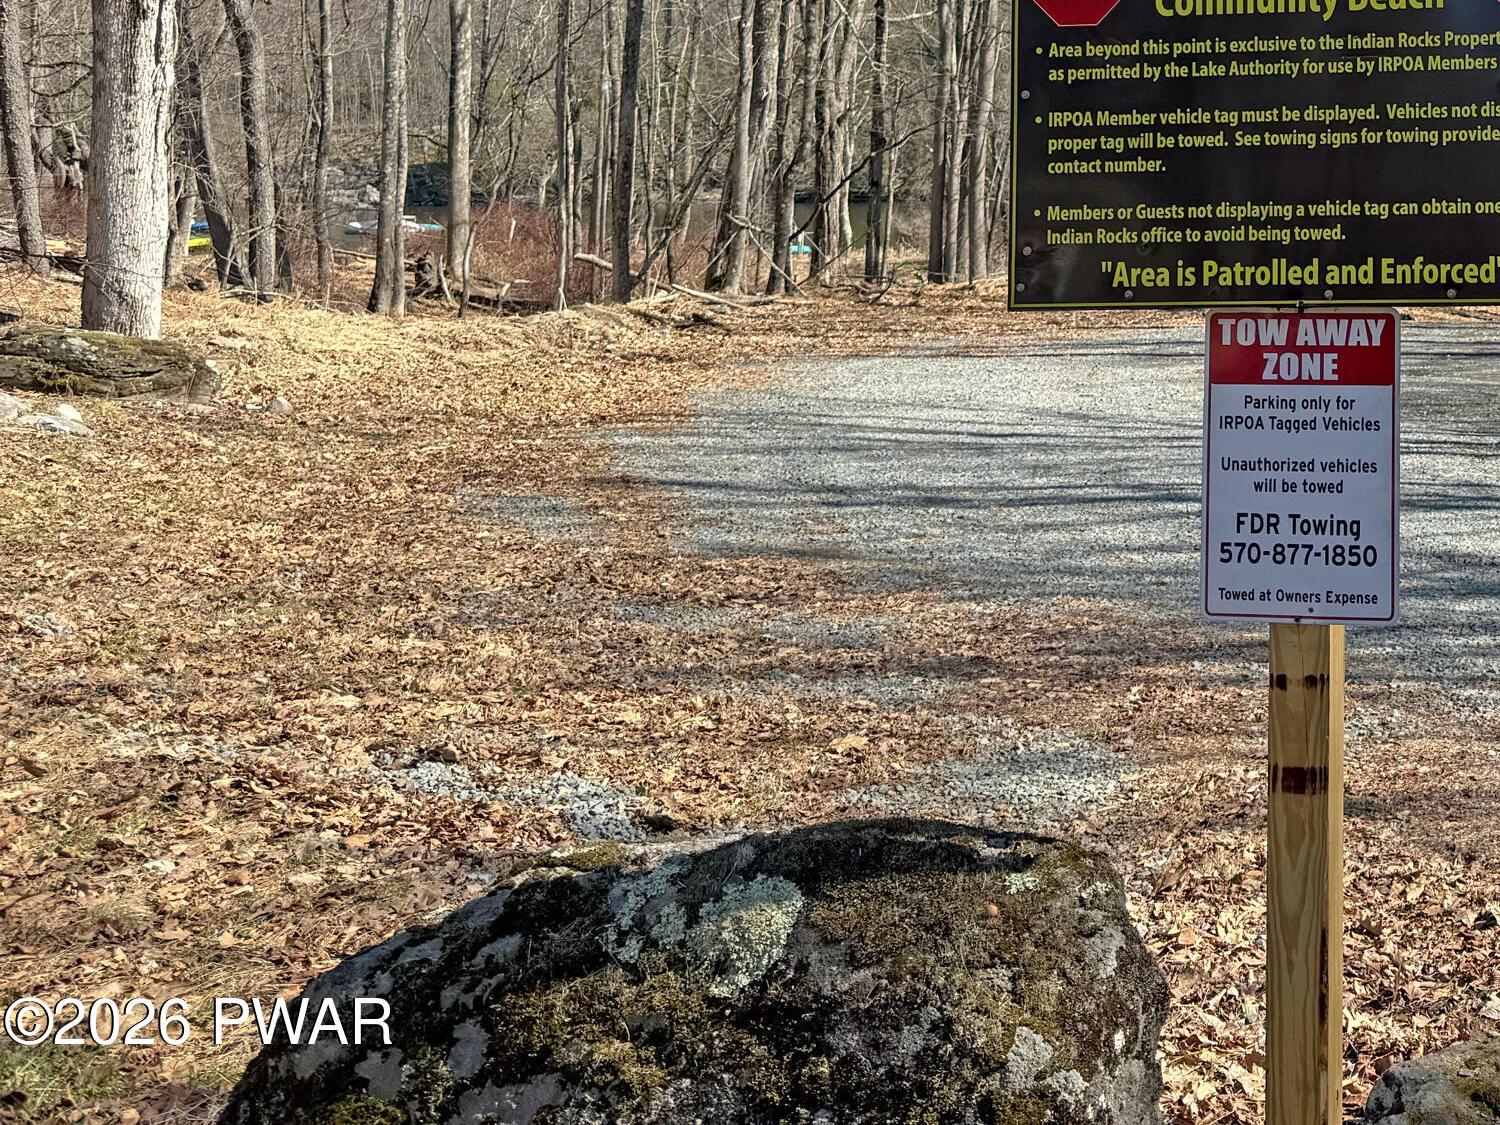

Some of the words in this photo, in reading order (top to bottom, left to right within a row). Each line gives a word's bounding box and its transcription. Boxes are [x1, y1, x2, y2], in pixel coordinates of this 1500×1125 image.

[1049, 43, 1082, 57] Area
[1086, 40, 1139, 60] beyond
[1143, 39, 1169, 54] this
[1174, 38, 1211, 57] point
[1216, 38, 1226, 52] is
[1230, 36, 1297, 52] exclusive
[1300, 37, 1315, 50] to
[1319, 35, 1343, 49] the
[1348, 33, 1394, 49] Indian
[1399, 32, 1440, 47] Rocks
[1049, 70, 1064, 80] as
[1068, 63, 1139, 84] permitted
[1144, 63, 1161, 82] by
[1164, 62, 1188, 77] the
[1192, 61, 1225, 76] Lake
[1229, 59, 1299, 78] Authority
[1303, 58, 1324, 73] for
[1328, 62, 1353, 73] use
[1357, 57, 1374, 76] by
[1379, 56, 1424, 71] IRPOA
[1428, 54, 1497, 70] Members
[1049, 112, 1093, 127] IRPOA
[1097, 110, 1156, 125] Member
[1160, 108, 1210, 124] vehicle
[1214, 110, 1238, 126] tag
[1242, 108, 1278, 122] must
[1283, 106, 1300, 121] be
[1387, 103, 1448, 119] Vehicles
[1452, 104, 1477, 117] not
[1049, 139, 1097, 154] proper
[1100, 136, 1123, 153] tag
[1127, 133, 1153, 148] will
[1157, 133, 1174, 147] be
[1235, 131, 1261, 146] See
[1264, 130, 1316, 148] towing
[1320, 129, 1357, 148] signs
[1361, 128, 1383, 143] for
[1386, 127, 1438, 146] towing
[1048, 159, 1101, 173] contact
[1048, 205, 1114, 220] Members
[1118, 208, 1133, 219] or
[1136, 204, 1184, 219] Guests
[1188, 204, 1212, 218] not
[1216, 202, 1292, 221] displaying
[1296, 205, 1304, 216] a
[1308, 200, 1360, 216] vehicle
[1364, 202, 1388, 219] tag
[1393, 203, 1418, 214] can
[1422, 198, 1471, 214] obtain
[1048, 229, 1092, 244] Indian
[1097, 228, 1137, 243] Rocks
[1141, 227, 1182, 244] office
[1186, 228, 1200, 242] to
[1205, 226, 1244, 241] avoid
[1249, 226, 1290, 244] being
[1178, 260, 1195, 286] is
[1203, 258, 1318, 286] Patrolled
[1326, 257, 1373, 284] and
[1218, 319, 1289, 346] TOW
[1296, 319, 1385, 346] AWAY
[1262, 353, 1338, 380] ZONE
[1245, 395, 1296, 412] Parking
[1302, 396, 1330, 413] only
[1336, 396, 1355, 410] for
[1220, 416, 1264, 429] IRPOA
[1269, 416, 1316, 433] Tagged
[1323, 417, 1380, 431] Vehicles
[1222, 457, 1314, 472] Unauthorized
[1320, 459, 1377, 473] vehicles
[1254, 478, 1276, 492] will
[1282, 479, 1297, 492] be
[1302, 479, 1343, 493] towed
[1237, 513, 1279, 534] FDR
[1288, 514, 1360, 541] Towing
[1220, 542, 1377, 567] 570-877-1850
[1218, 588, 1254, 600] Towed
[1259, 589, 1271, 601] at
[1276, 589, 1321, 603] Owners
[1326, 591, 1378, 606] Expense
